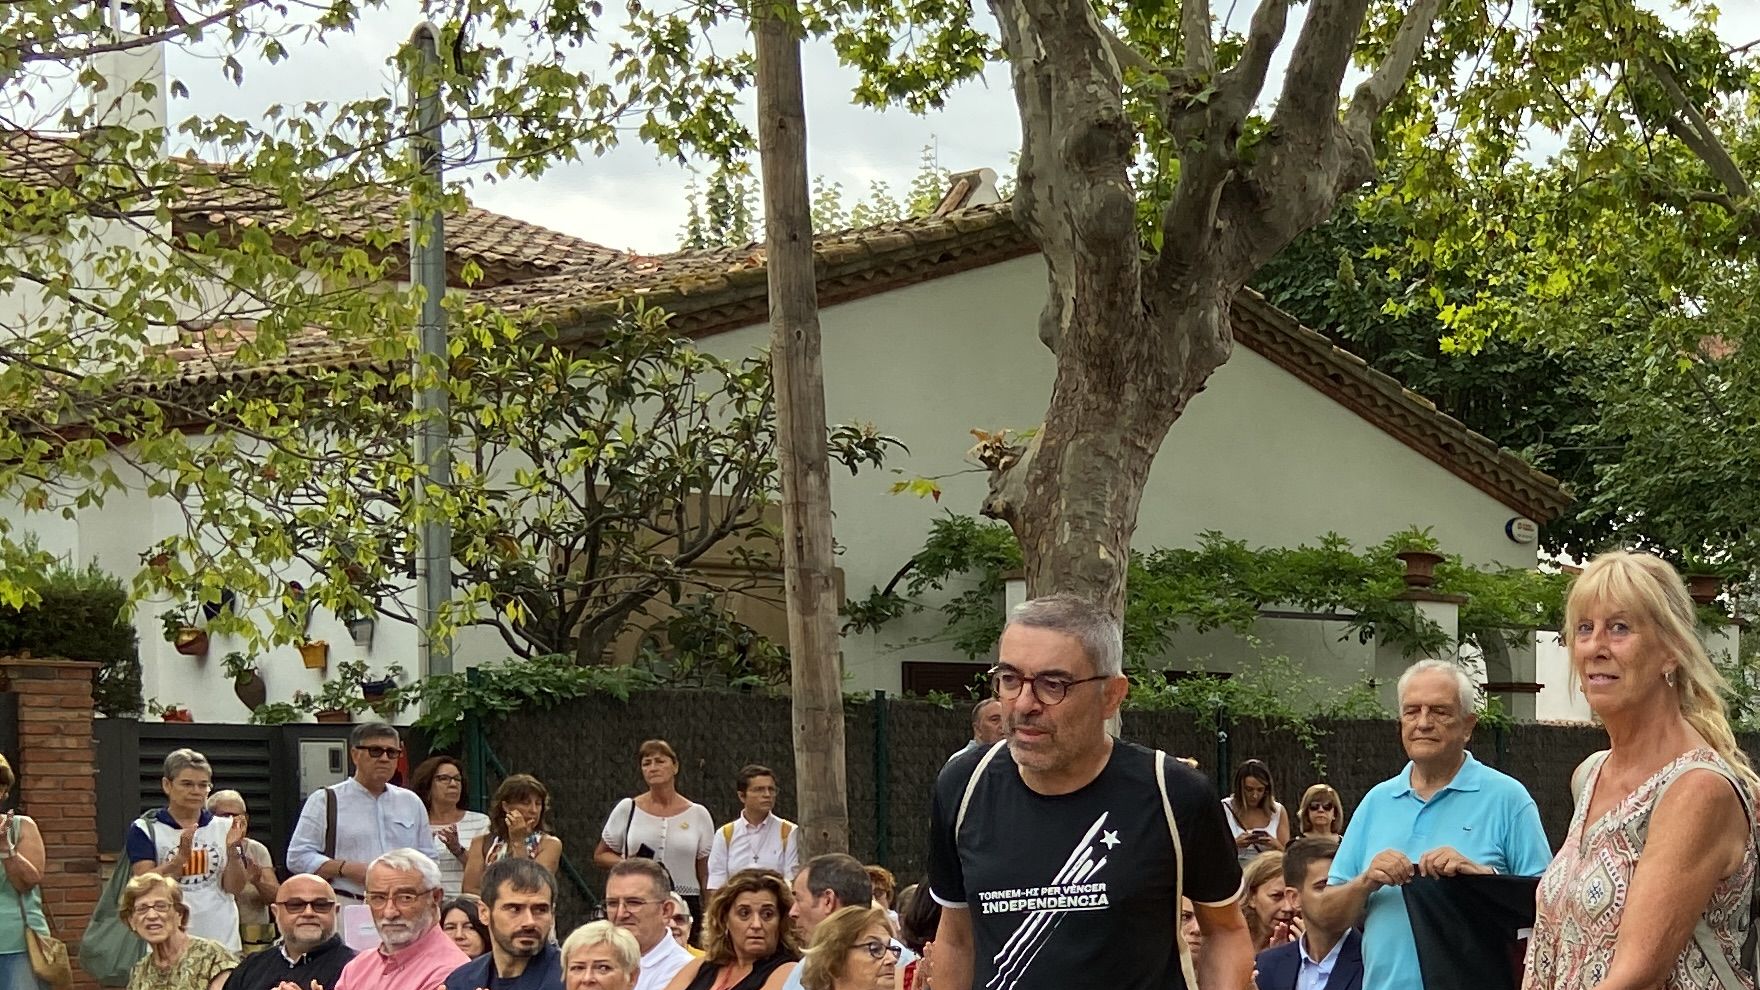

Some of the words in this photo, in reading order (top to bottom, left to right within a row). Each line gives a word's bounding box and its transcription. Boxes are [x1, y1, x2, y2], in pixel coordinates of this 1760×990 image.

[978, 887, 1040, 901] TORNEM-HI
[1041, 886, 1061, 897] PER
[1062, 883, 1107, 895] VÈNCER
[981, 893, 1110, 914] INDEPENDÈNCIA
